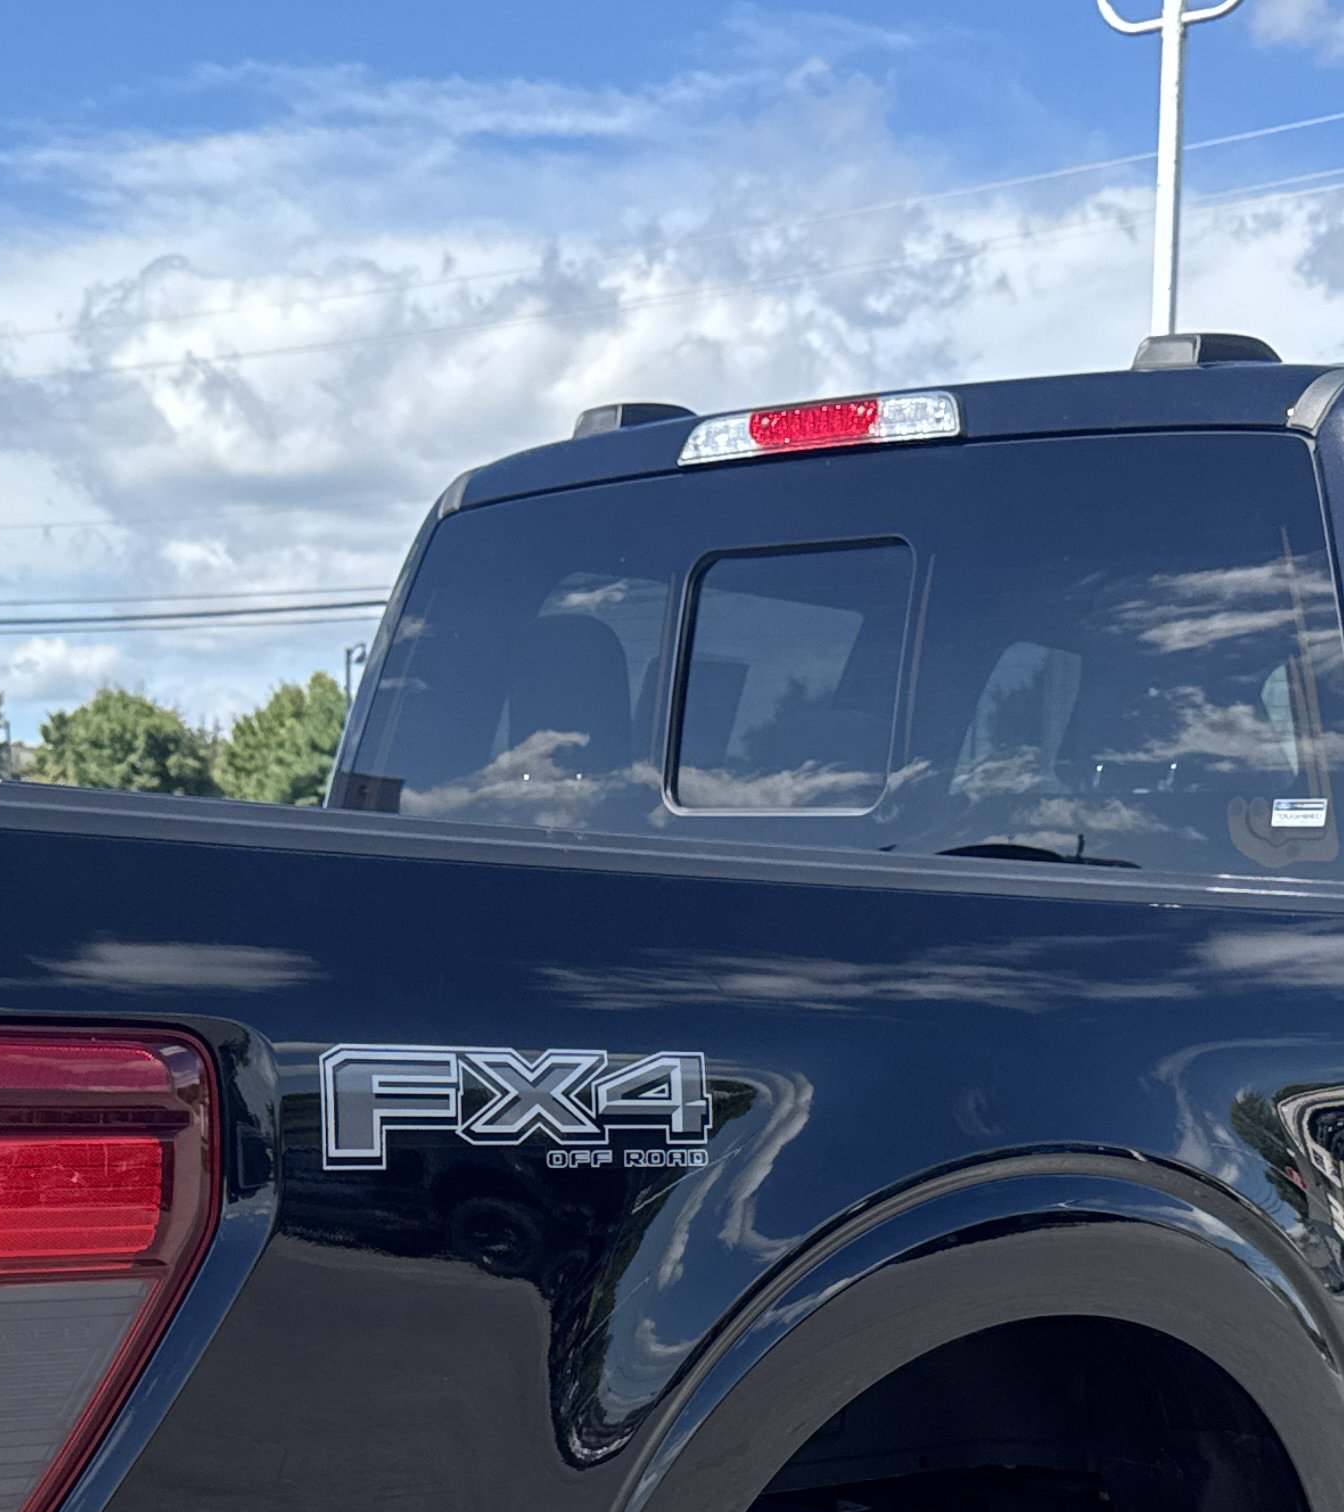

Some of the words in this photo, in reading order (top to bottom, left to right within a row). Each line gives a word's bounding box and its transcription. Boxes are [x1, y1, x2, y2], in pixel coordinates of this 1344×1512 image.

[319, 1043, 713, 1171] FX4
[546, 1148, 613, 1170] OFF
[623, 1148, 709, 1169] ROAD
